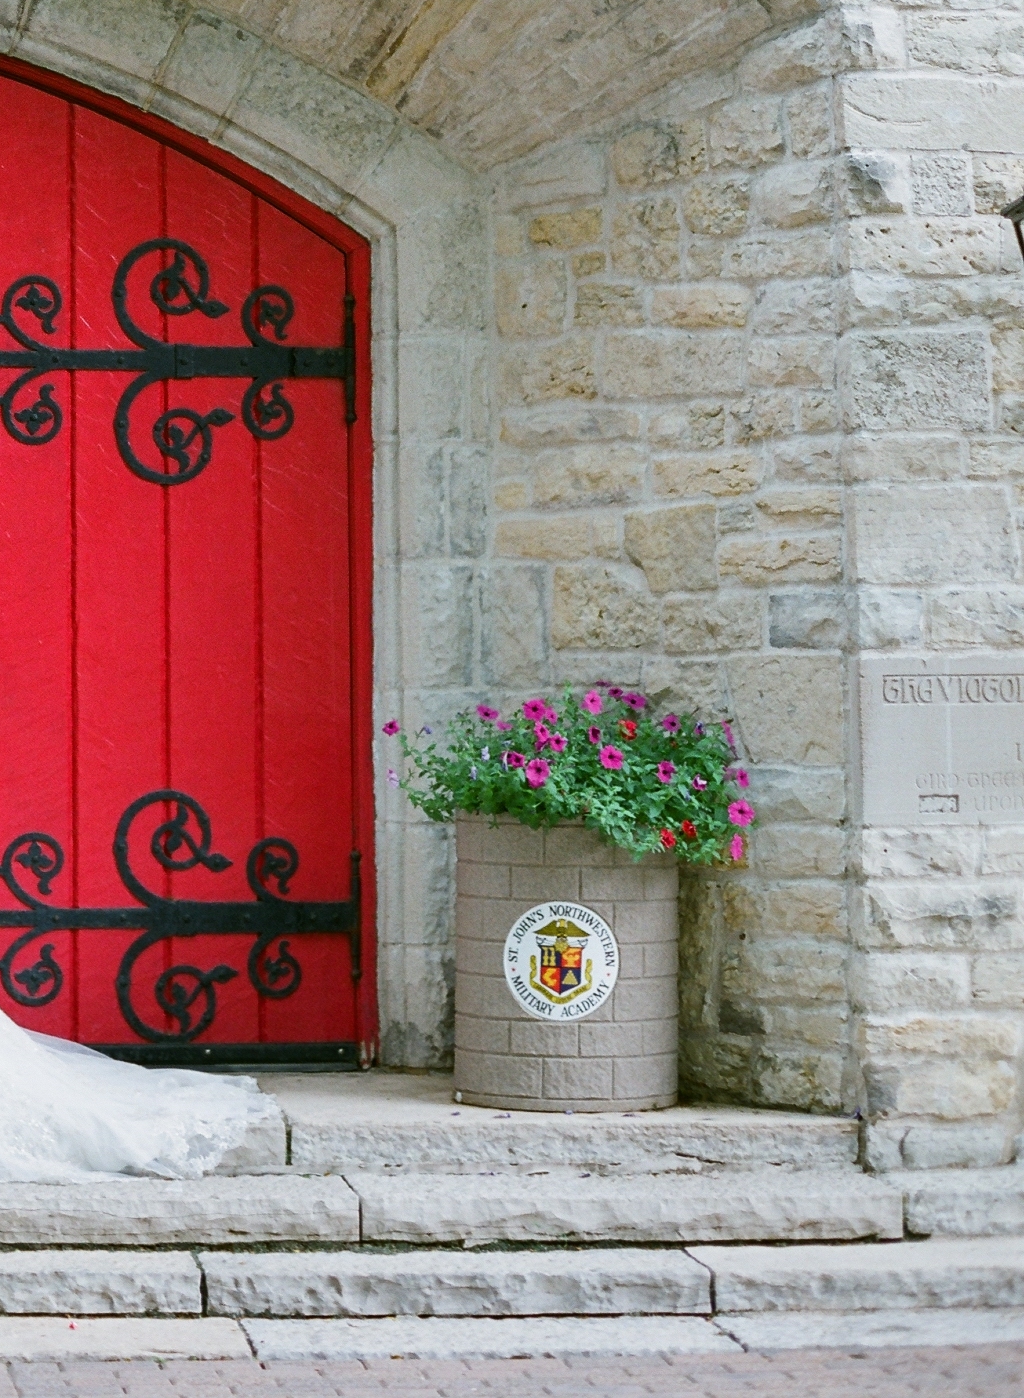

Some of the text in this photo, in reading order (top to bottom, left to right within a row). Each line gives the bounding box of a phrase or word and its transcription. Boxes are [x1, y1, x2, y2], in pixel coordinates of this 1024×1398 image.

[513, 908, 545, 944] JOHN'S
[548, 904, 616, 968] NORTHWESTERN
[511, 975, 555, 1016] MILITARY
[560, 979, 610, 1018] ACADEMY
